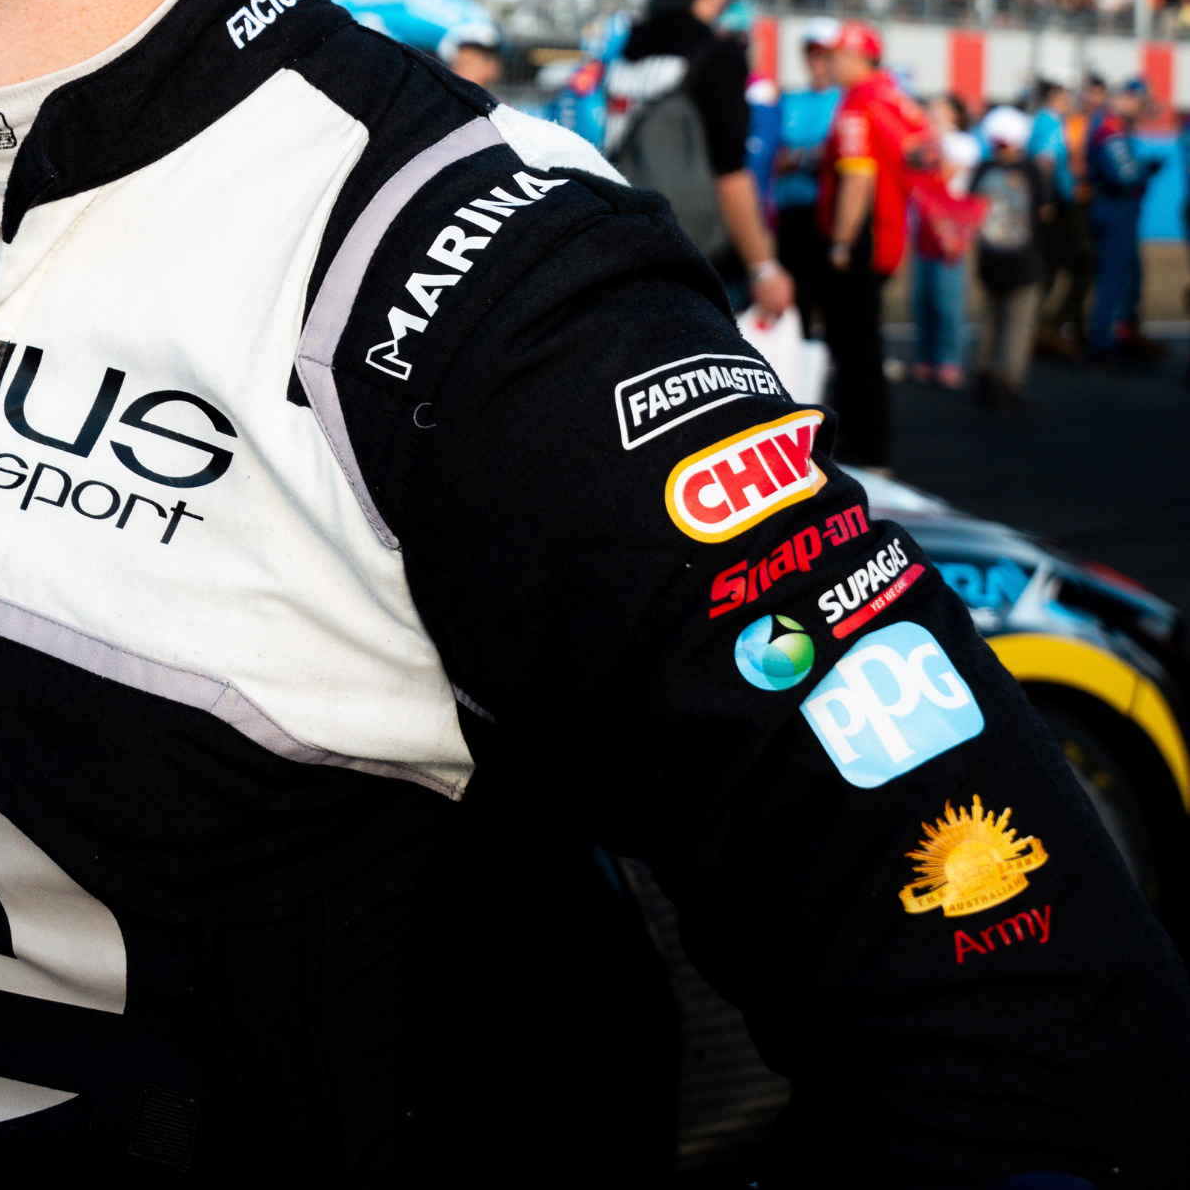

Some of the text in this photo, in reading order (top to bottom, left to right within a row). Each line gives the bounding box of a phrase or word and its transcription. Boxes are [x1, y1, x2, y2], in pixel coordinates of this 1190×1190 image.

[365, 171, 571, 381] MARINA
[628, 365, 782, 427] FASTMASTER
[682, 422, 820, 524] CHIK
[709, 504, 870, 619] Snap-on
[817, 538, 909, 624] SUPAGAS
[870, 596, 886, 612] YES
[883, 586, 897, 603] WE
[948, 877, 1022, 912] AUSTRALIAN
[953, 904, 1051, 965] Army
